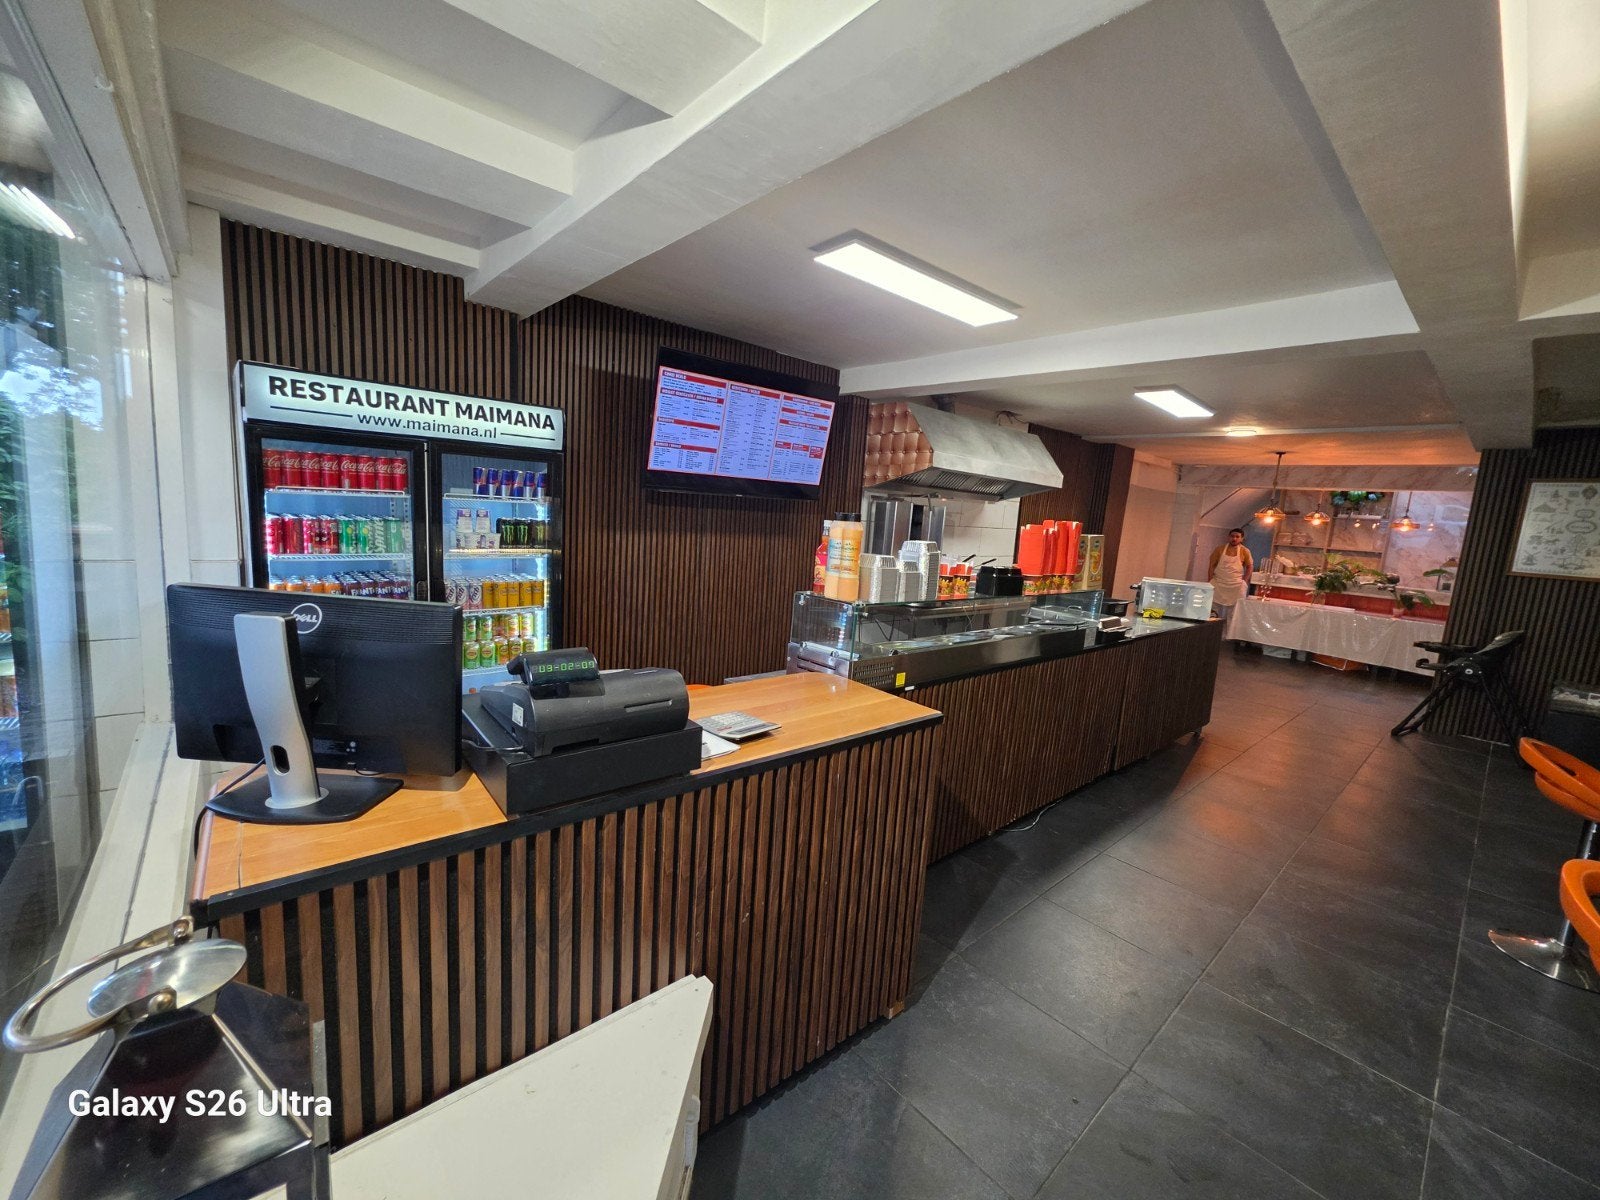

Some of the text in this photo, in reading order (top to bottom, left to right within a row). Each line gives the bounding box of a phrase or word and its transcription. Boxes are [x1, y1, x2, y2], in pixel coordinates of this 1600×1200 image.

[268, 375, 556, 431] RESTAURANT MAIMANA
[357, 412, 497, 439] www.maimana.nl
[293, 613, 318, 623] DELL
